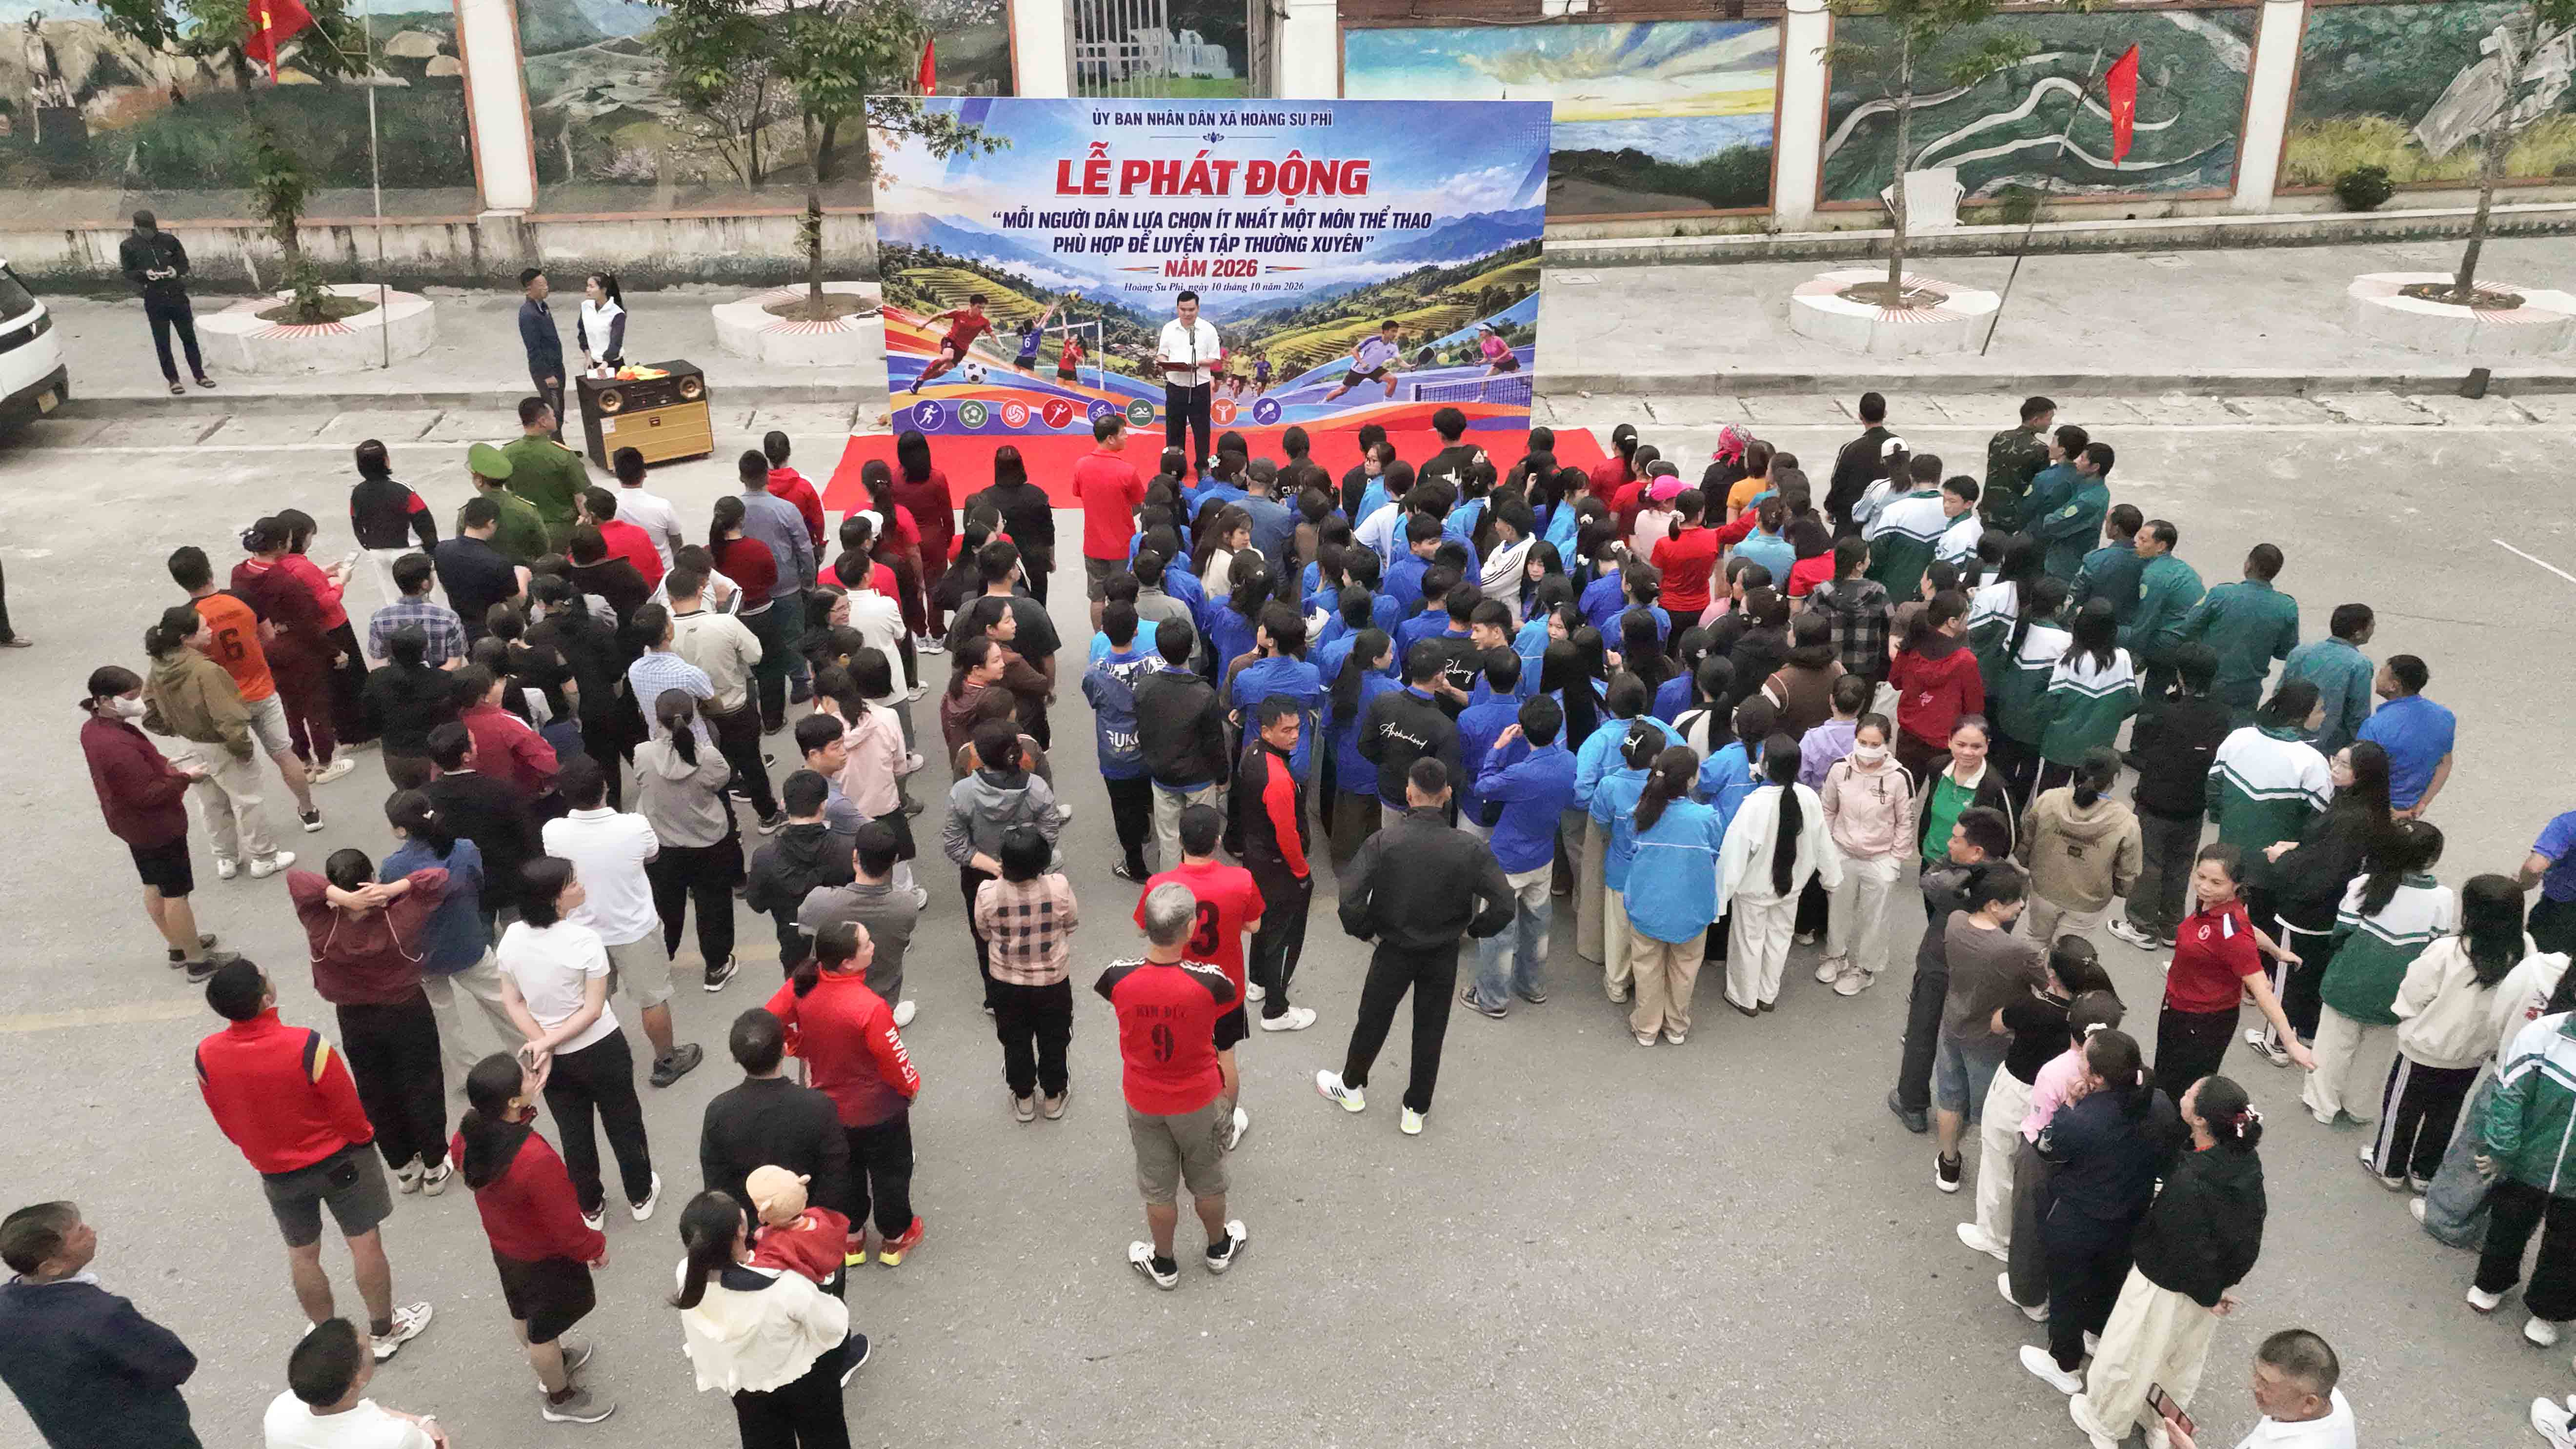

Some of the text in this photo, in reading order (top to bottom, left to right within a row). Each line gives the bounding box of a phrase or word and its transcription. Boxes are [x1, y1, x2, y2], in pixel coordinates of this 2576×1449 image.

[1093, 108, 1332, 126] ỦY BAN NHÂN DÂN XÃ HOÀNG SU PHÌ
[1056, 141, 1370, 206] LỄ PHÁT ĐỘNG
[1038, 208, 1090, 229] NGƯỜI
[1094, 208, 1129, 229] DÂN
[1133, 212, 1164, 232] LỰA
[1168, 212, 1212, 232] CHỌN
[1216, 206, 1232, 229] ÍT
[1234, 206, 1280, 229] NHẤT
[1281, 208, 1316, 233] MỘT
[1319, 208, 1356, 229] MÔN
[1359, 205, 1391, 229] THỂ
[1392, 212, 1432, 229] THAO
[1053, 232, 1087, 253] PHÙ
[1090, 236, 1125, 257] HỢP
[1127, 230, 1152, 253] ĐỂ
[1153, 233, 1205, 256] LUYỆN
[1209, 233, 1240, 256] TẬP
[1244, 233, 1308, 253] THƯỜNG
[1164, 255, 1258, 278] NĂM 2026
[1124, 282, 1153, 293] Hoàng
[1155, 282, 1167, 291] Su
[1188, 283, 1208, 293] ngày
[1211, 282, 1222, 291] 10
[1223, 282, 1248, 293] tháng
[1250, 282, 1261, 291] 10
[1263, 282, 1281, 291] năm
[1284, 282, 1304, 291] 2026
[1025, 337, 1030, 348] 6
[219, 628, 244, 659] 6
[1190, 900, 1219, 957] 3
[1151, 1024, 1175, 1063] 9
